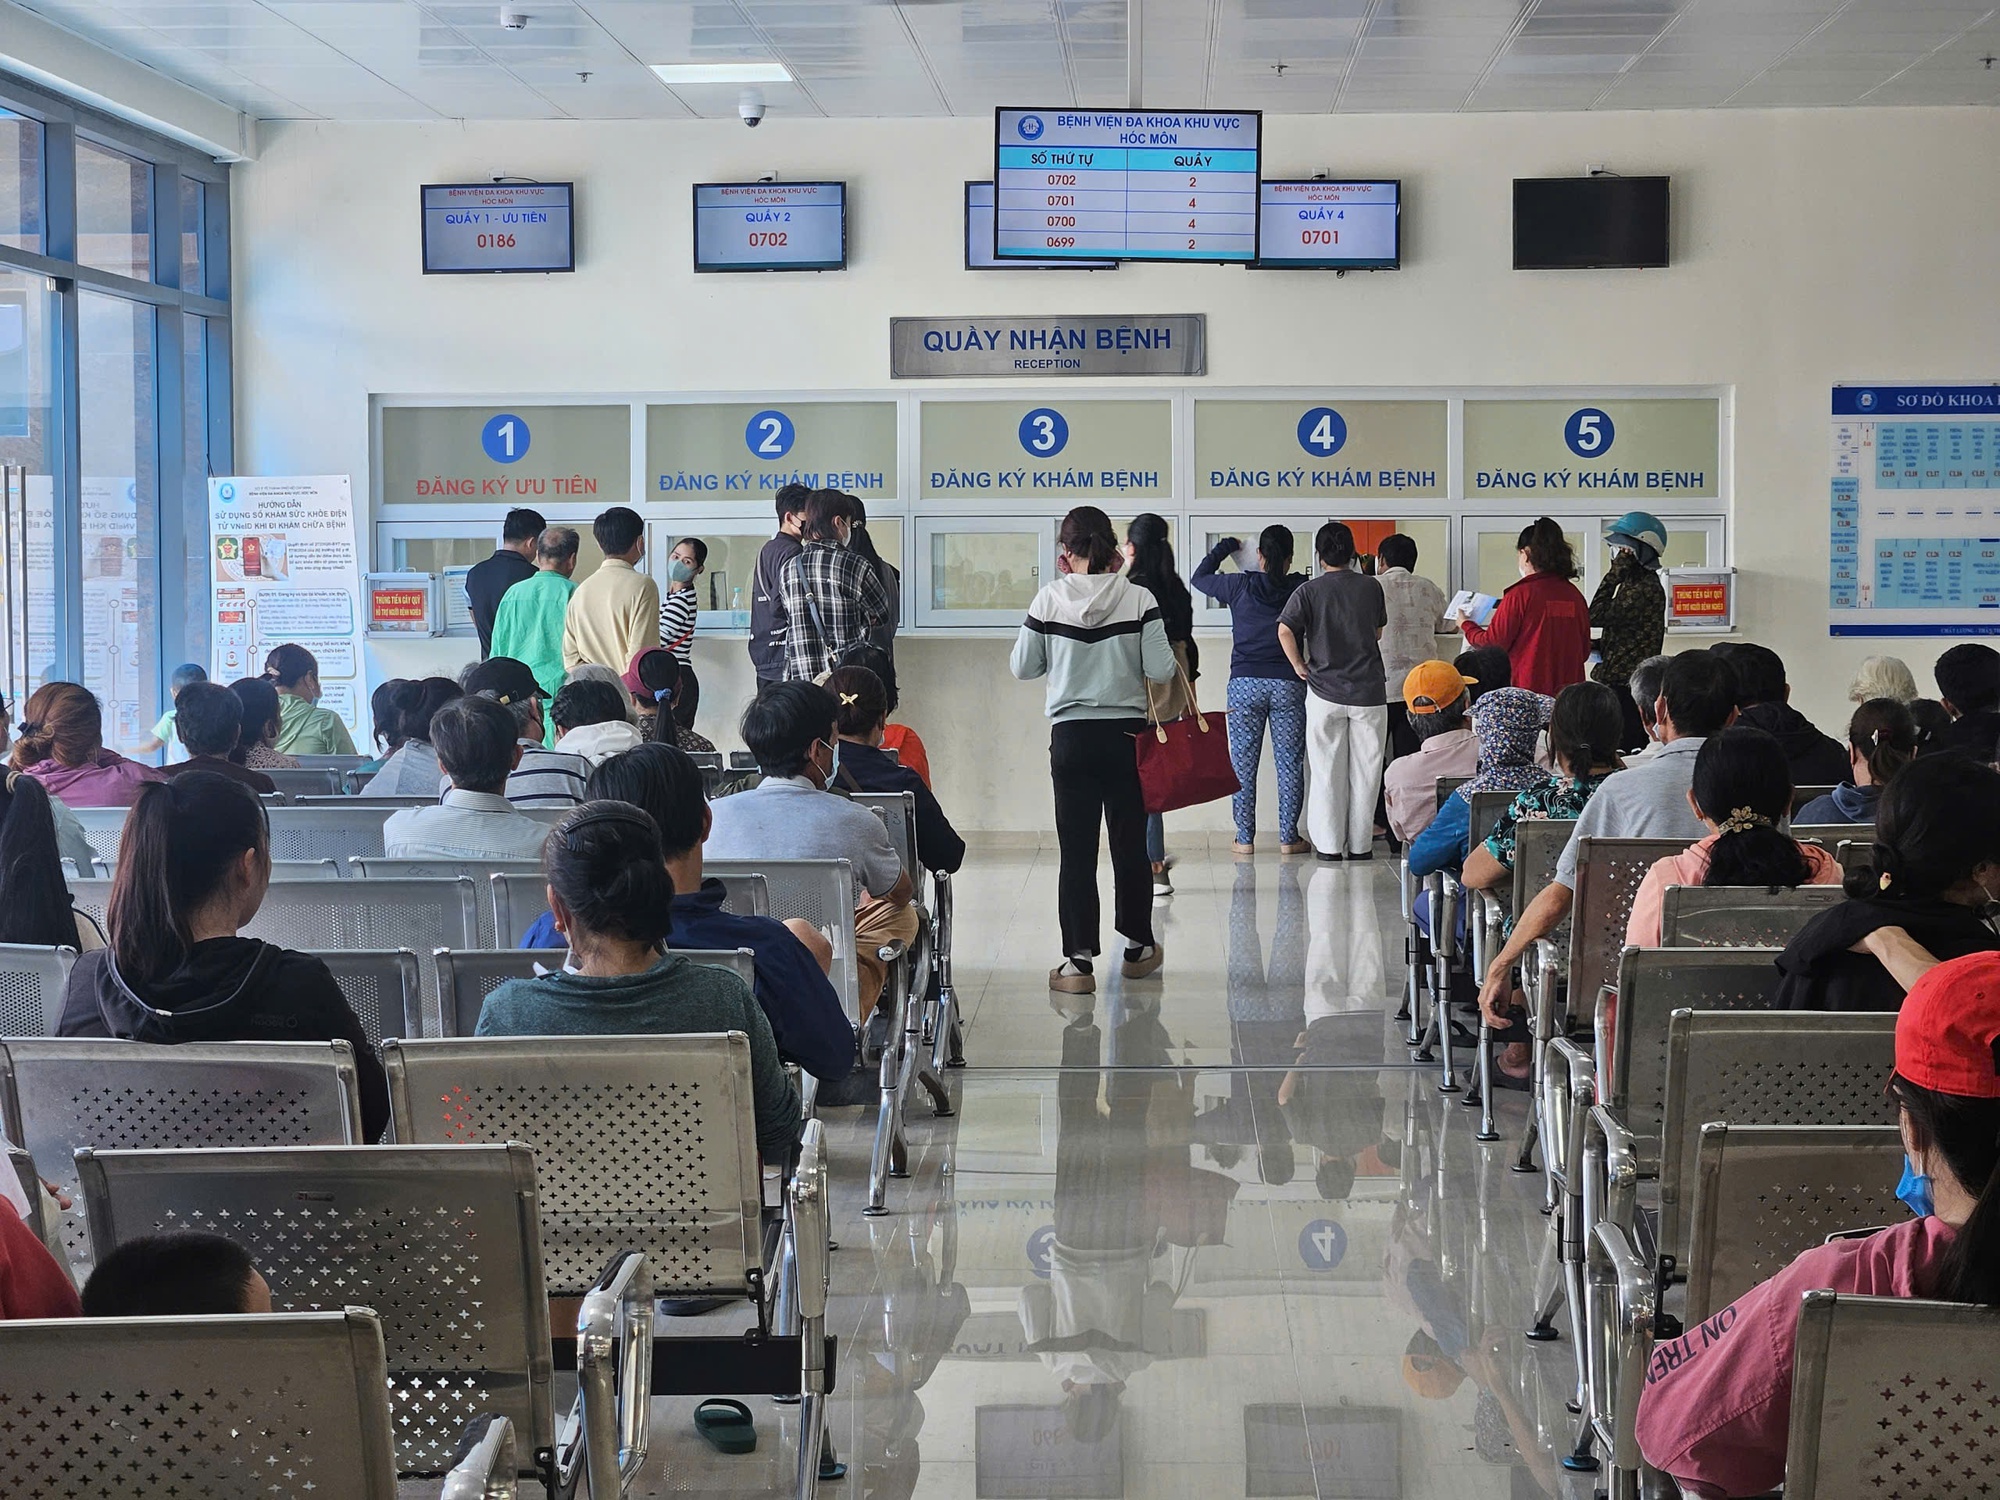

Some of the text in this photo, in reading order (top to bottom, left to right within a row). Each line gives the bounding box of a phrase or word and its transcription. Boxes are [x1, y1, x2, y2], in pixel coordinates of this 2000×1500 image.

[1058, 115, 1240, 131] BỆNH VIỆN ĐA KHOA KHU VỰC
[1120, 131, 1177, 145] HÓC MÔN
[1031, 150, 1094, 167] SỐ THỨ TỰ
[1048, 175, 1076, 185] 0702
[1189, 177, 1196, 187] 2
[1048, 195, 1075, 206] 0701
[1188, 198, 1196, 208] 4
[485, 214, 489, 223] 1
[503, 213, 519, 223] ƯU
[523, 211, 546, 223] TIÊN
[785, 212, 791, 221] 2
[1047, 216, 1075, 227] 0700
[1337, 210, 1344, 219] 4
[1188, 219, 1196, 229] 4
[477, 234, 515, 248] 0186
[749, 233, 787, 246] 0702
[1047, 237, 1075, 247] 0699
[1188, 239, 1196, 249] 2
[1302, 230, 1339, 244] 0701
[923, 325, 1171, 355] QUẦY NHẬN BỆNH
[1014, 359, 1080, 369] RECEPTION
[1897, 392, 1993, 406] SƠ ĐỒ KHOA
[498, 422, 514, 456] 1
[759, 418, 782, 453] 2
[1032, 416, 1055, 450] 3
[1309, 415, 1334, 449] 4
[1577, 416, 1601, 451] 5
[416, 474, 597, 495] ĐĂNG KÝ ƯU TIÊN
[659, 470, 882, 493] ĐĂNG KÝ KHÁM BỆNH
[931, 468, 1157, 491] ĐĂNG KÝ KHÁM BỆNH
[1210, 467, 1435, 490] ĐĂNG KÝ KHÁM BỆNH
[1476, 468, 1703, 492] ĐĂNG KÝ KHÁM BỆNH
[287, 499, 301, 508] DẪN
[1701, 1306, 1736, 1348] ON
